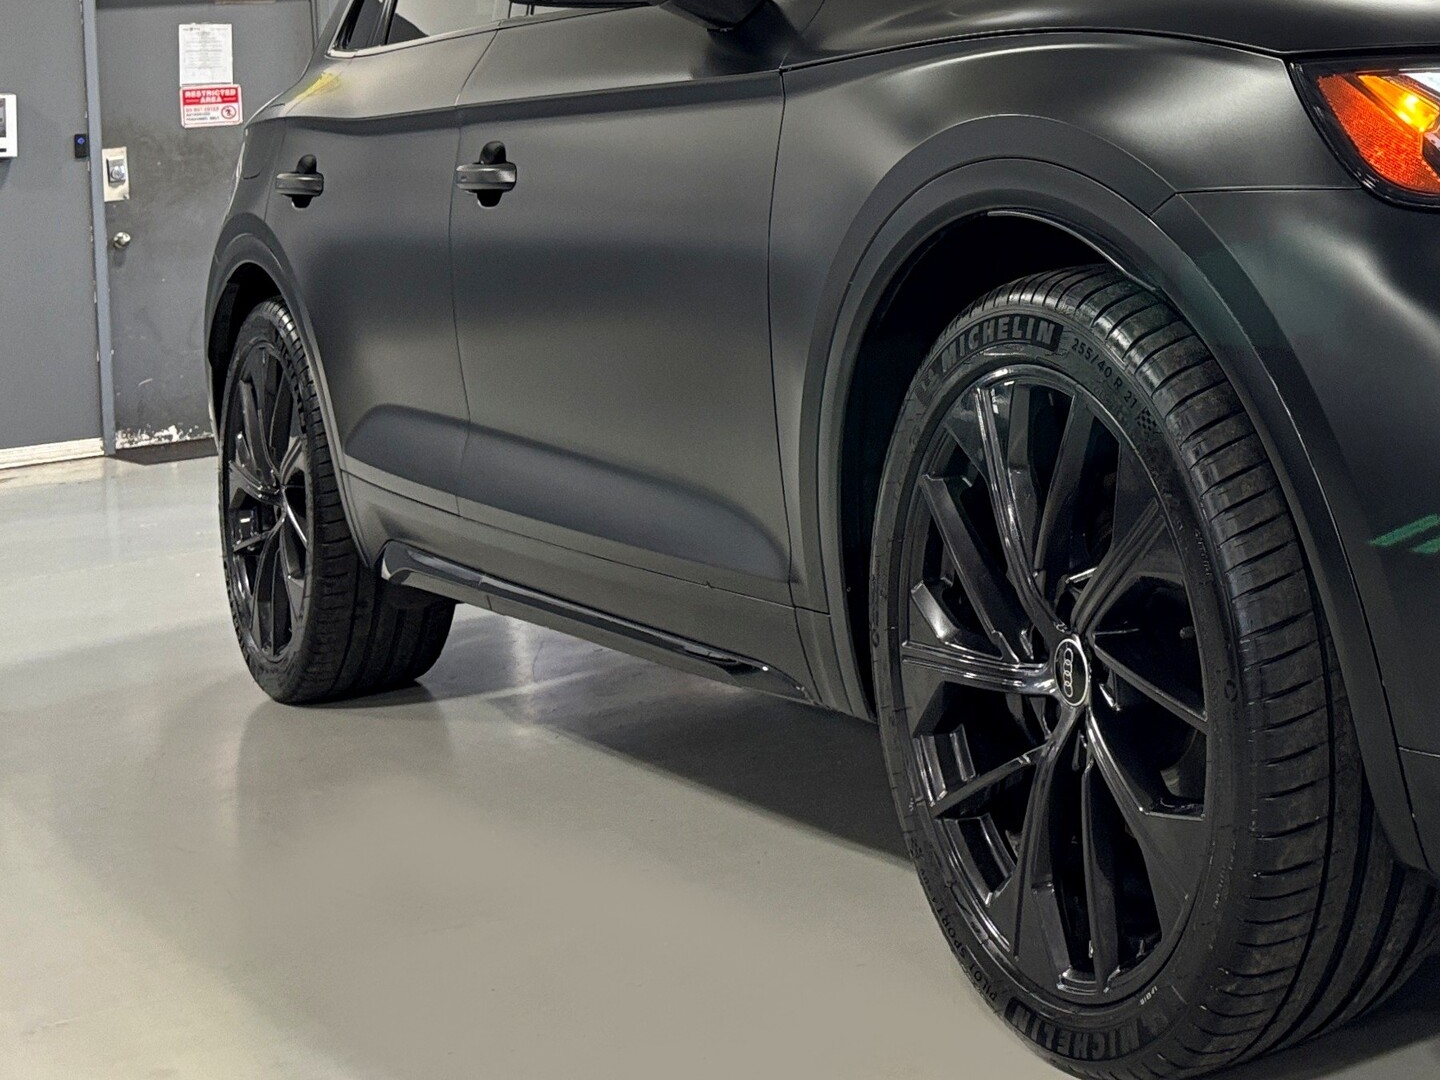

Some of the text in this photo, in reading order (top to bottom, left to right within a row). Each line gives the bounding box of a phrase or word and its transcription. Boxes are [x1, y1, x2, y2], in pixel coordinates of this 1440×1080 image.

[184, 89, 236, 98] RESTRICTED
[941, 316, 1055, 373] MICHELIN
[1071, 338, 1138, 409] 255/40 R 21
[1010, 1005, 1140, 1058] MICHELIN
